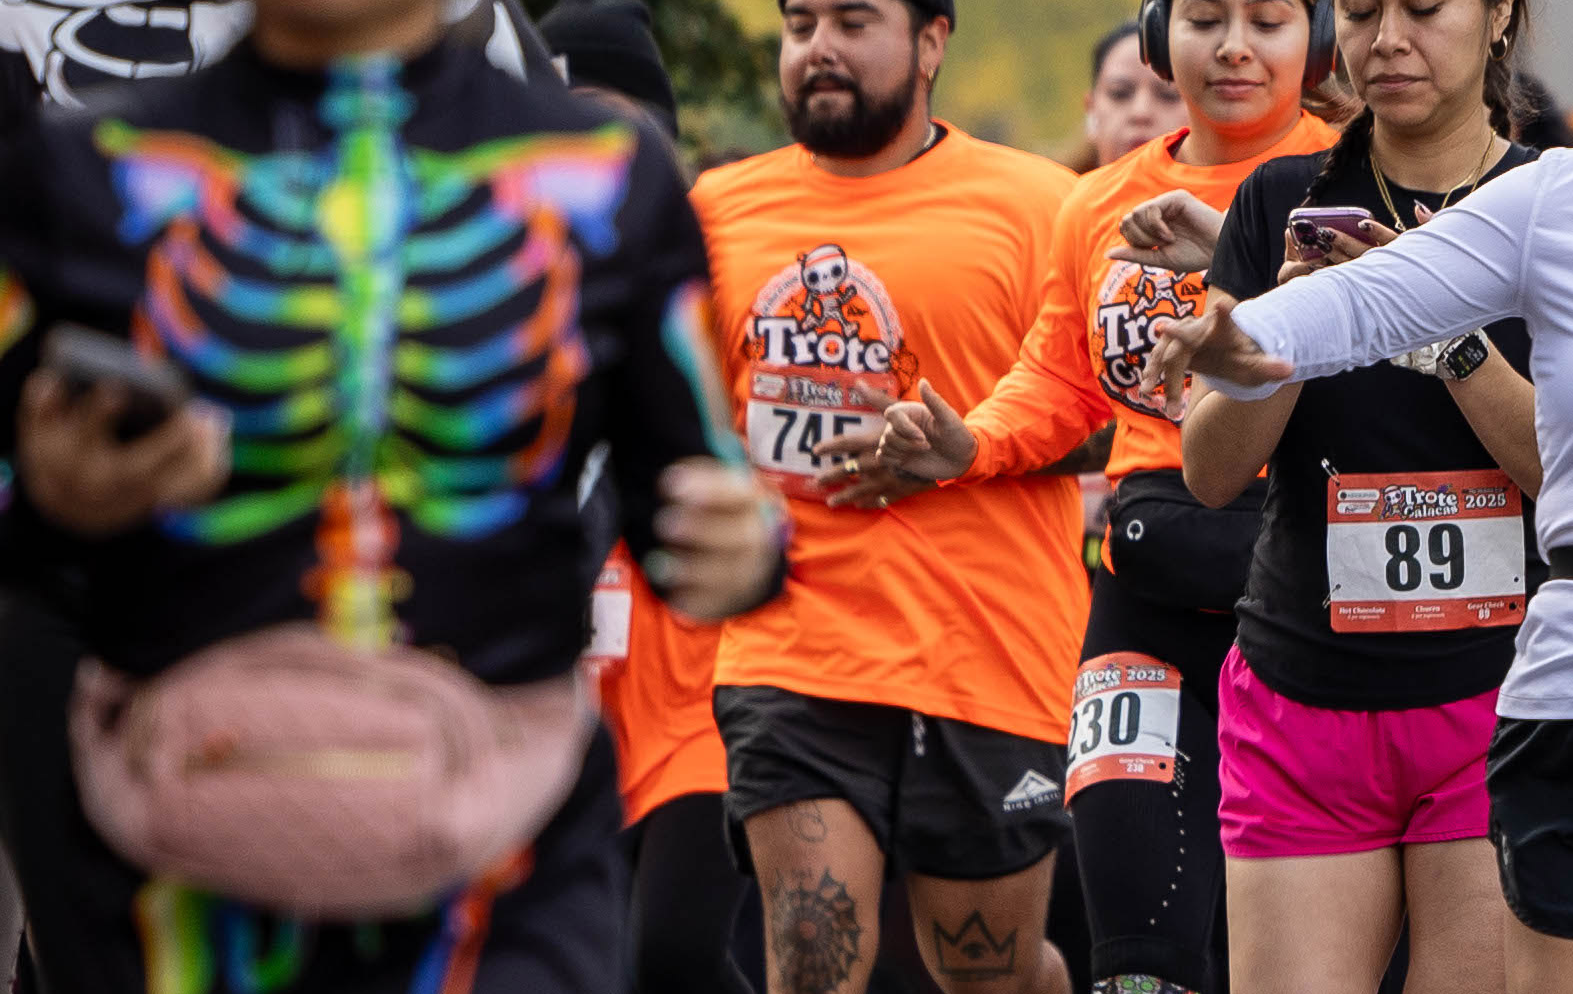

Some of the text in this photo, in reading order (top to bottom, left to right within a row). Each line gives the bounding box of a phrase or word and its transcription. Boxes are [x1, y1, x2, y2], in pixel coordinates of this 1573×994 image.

[1099, 304, 1178, 357] Tro
[757, 316, 890, 374] Trote
[1401, 485, 1458, 507] Trote
[1465, 493, 1507, 509] 2025
[1403, 504, 1459, 519] Calacas
[1385, 523, 1465, 592] 89
[1478, 608, 1491, 620] 89
[1126, 668, 1167, 682] 2025
